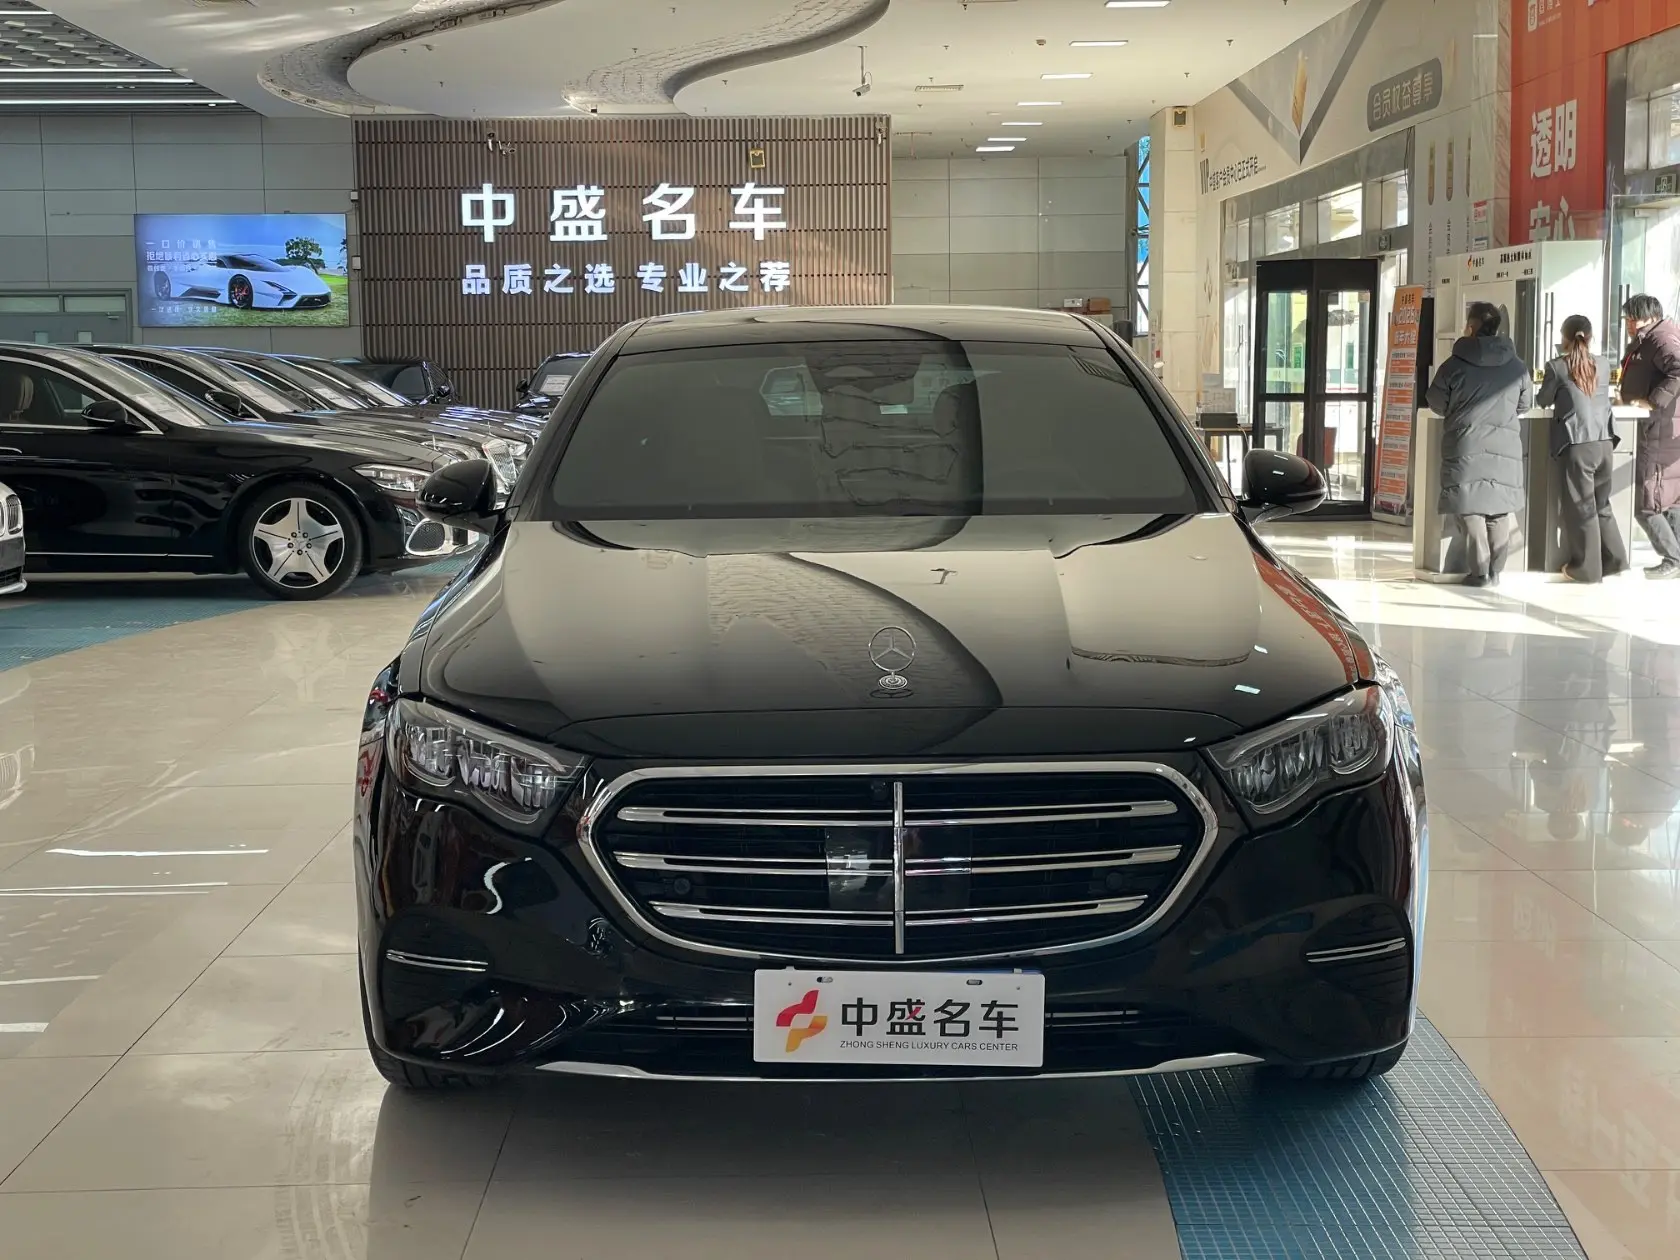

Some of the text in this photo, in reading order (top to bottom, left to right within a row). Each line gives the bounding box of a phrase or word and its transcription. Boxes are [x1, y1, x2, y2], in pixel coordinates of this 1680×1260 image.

[1373, 71, 1433, 121] 会员权益尊享
[1531, 99, 1578, 179] 透明
[461, 182, 787, 243] 中盛名车
[461, 260, 792, 295] 品质之选 专业之荐
[841, 997, 1019, 1039] 中盛名车
[839, 1040, 1019, 1051] ZHONG SHENG LUXURY CARS CENTER
